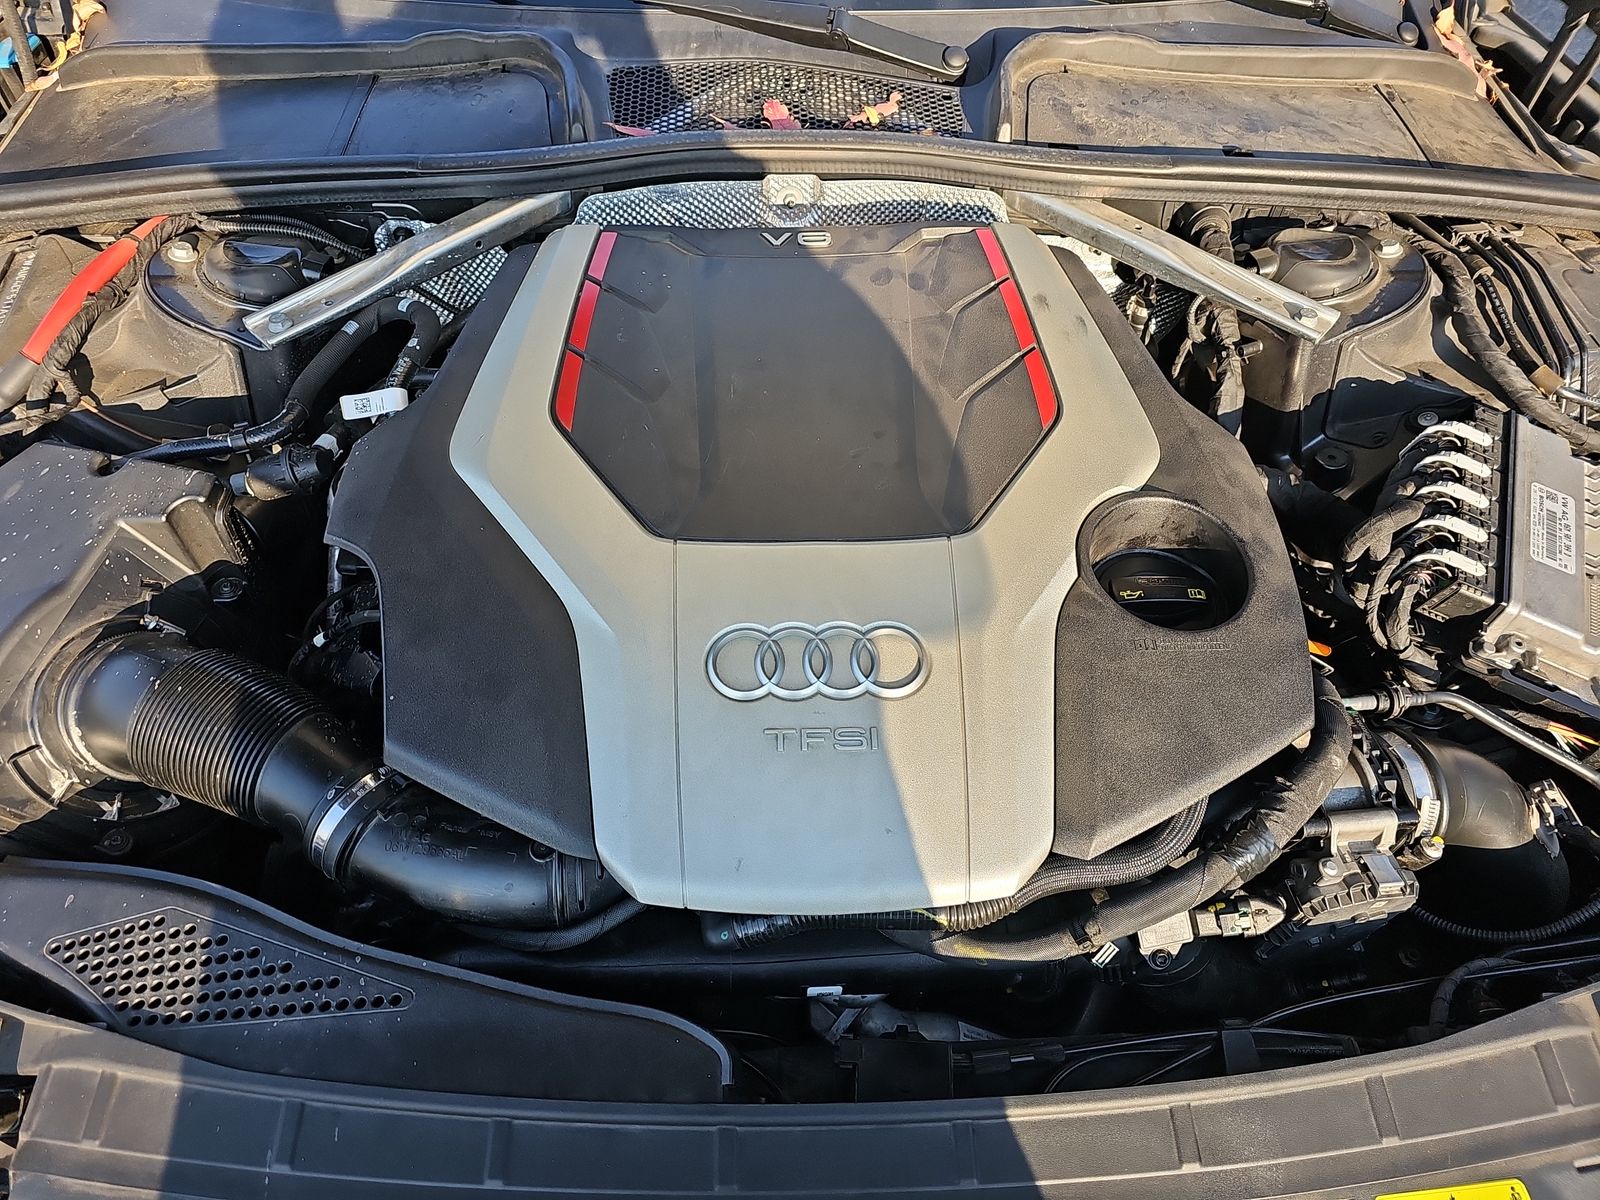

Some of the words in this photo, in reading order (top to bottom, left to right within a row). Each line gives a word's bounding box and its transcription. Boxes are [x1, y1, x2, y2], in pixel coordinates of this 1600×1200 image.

[760, 231, 833, 248] V6
[1561, 496, 1569, 510] VW
[1561, 509, 1569, 521] AG
[763, 726, 879, 753] TFSI
